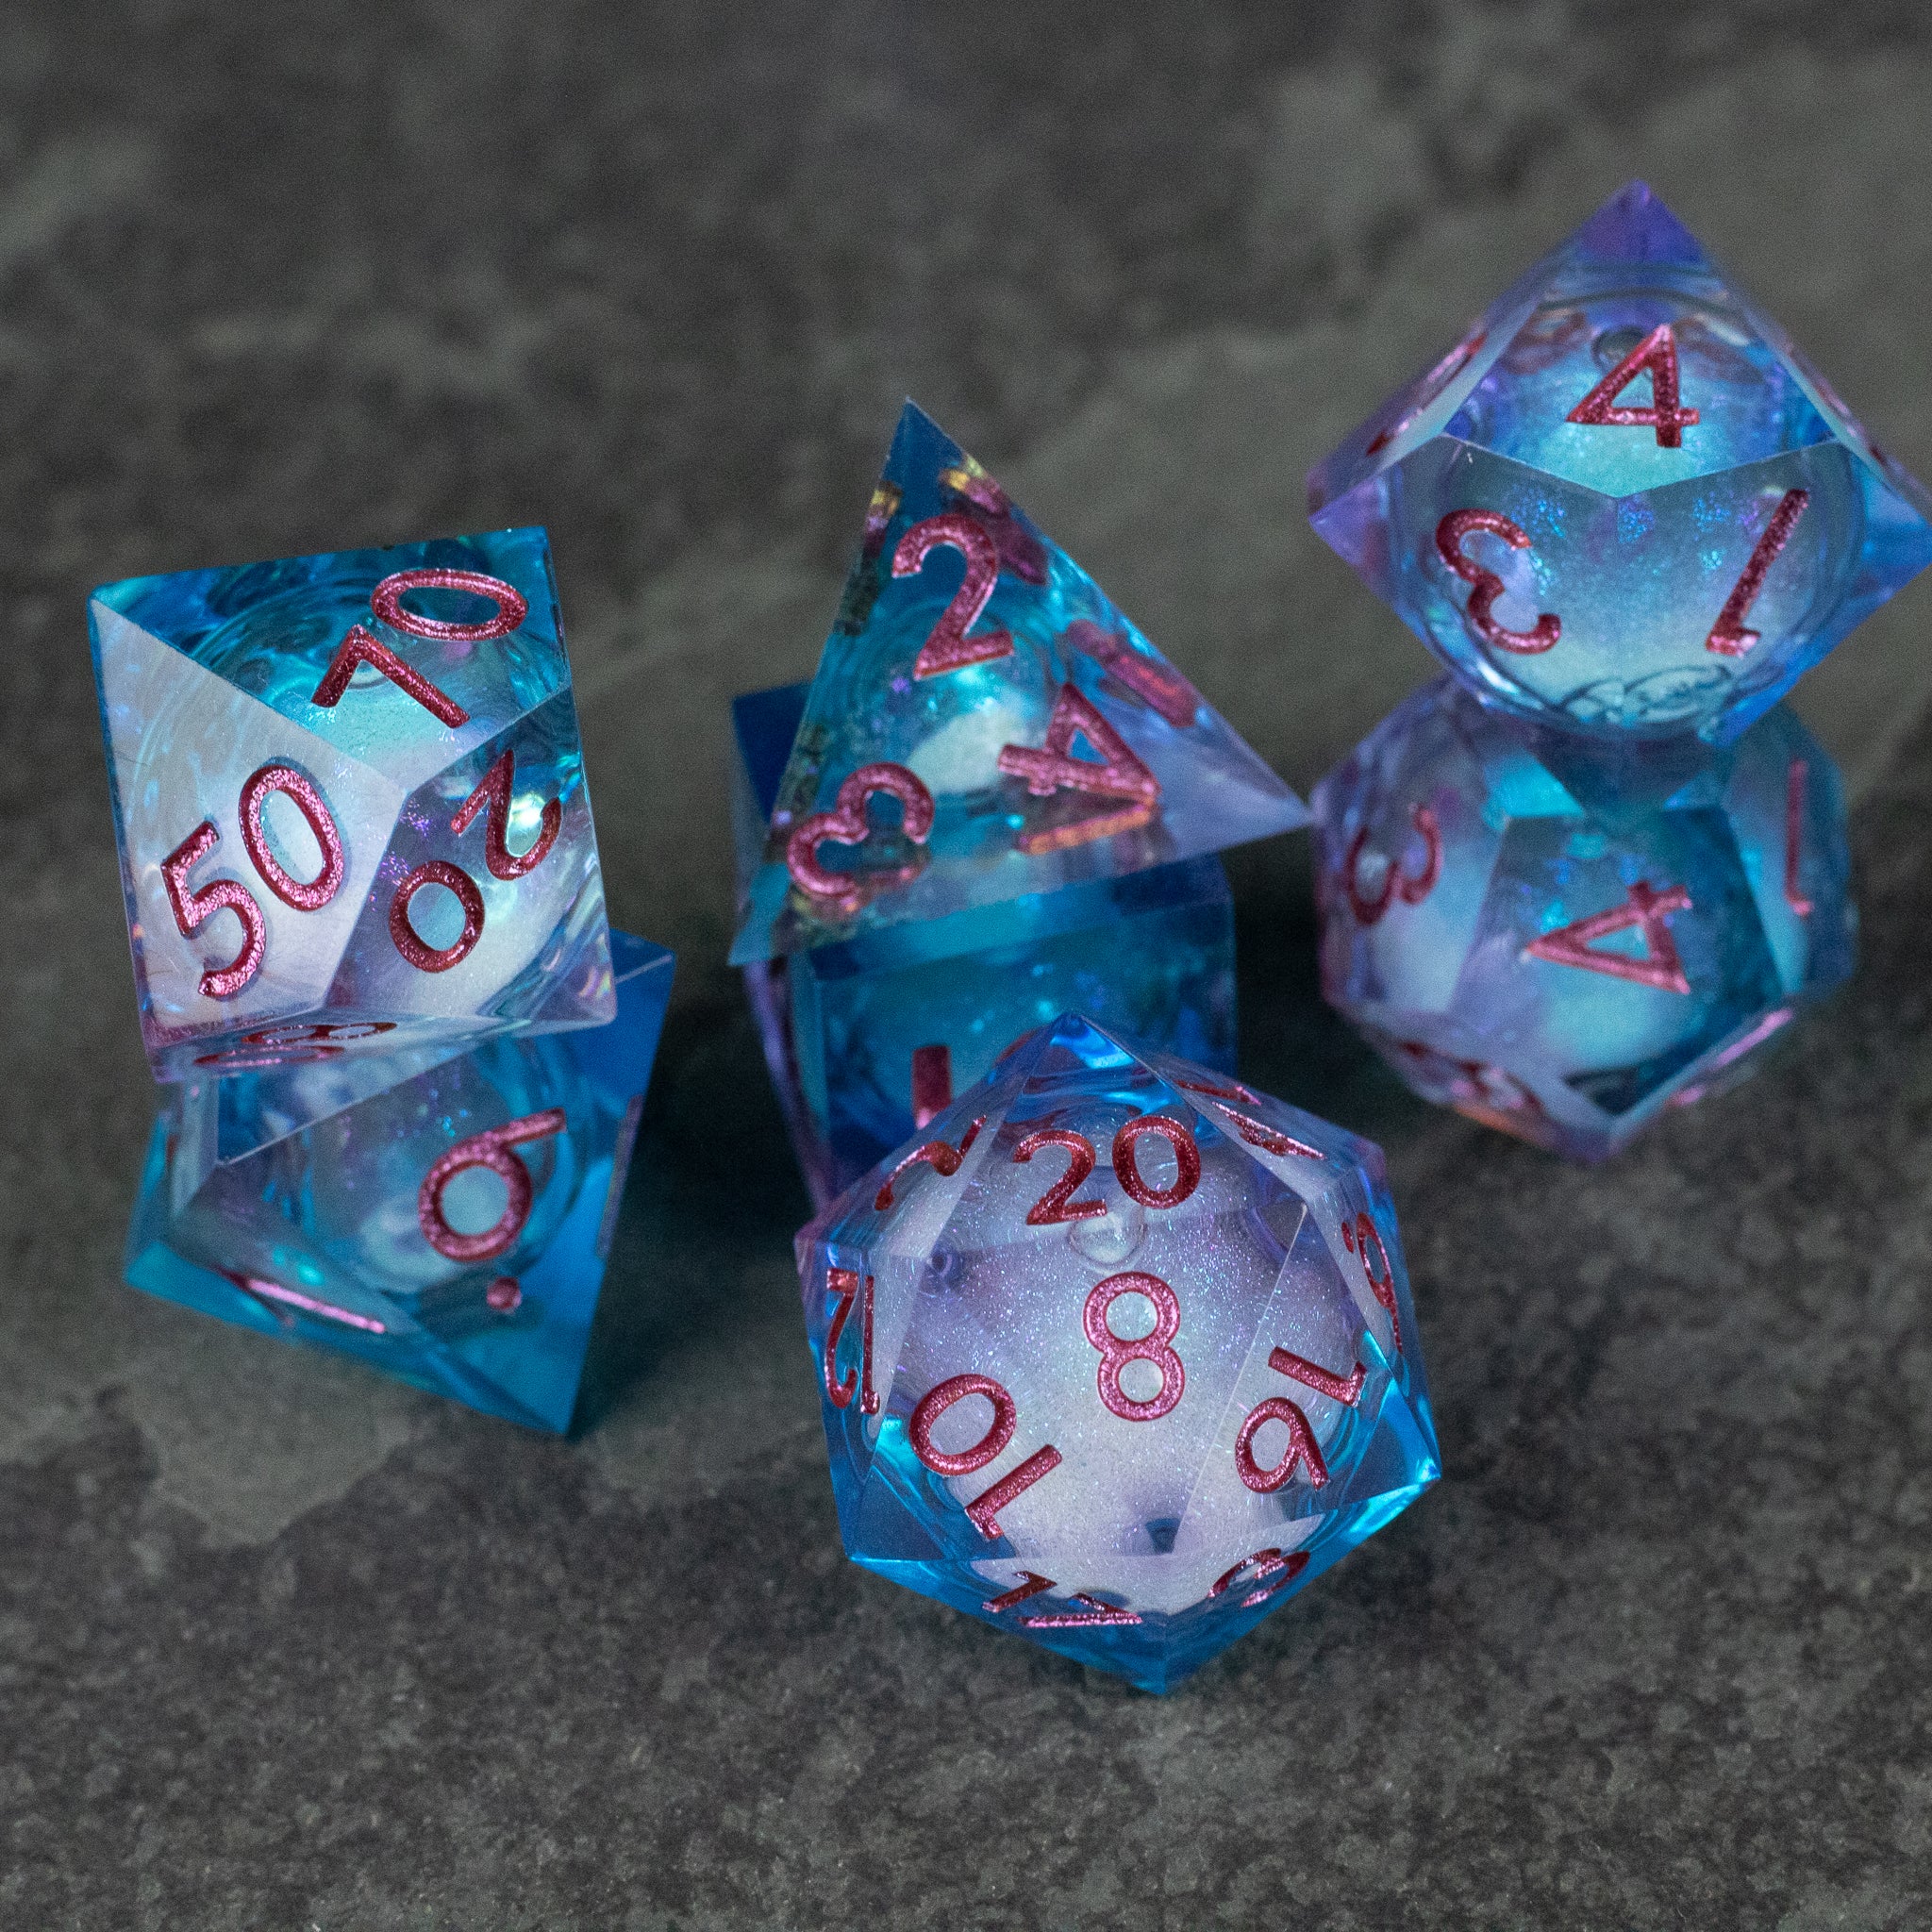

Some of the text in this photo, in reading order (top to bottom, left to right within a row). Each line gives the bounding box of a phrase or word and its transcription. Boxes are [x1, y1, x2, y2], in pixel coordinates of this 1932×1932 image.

[1566, 323, 1699, 448] 4
[312, 568, 528, 729] 70
[891, 513, 1015, 681] 2
[1436, 508, 1561, 656] 3
[997, 683, 1162, 802] 4
[160, 765, 344, 1000] 50
[390, 749, 562, 974] 20
[787, 762, 936, 898] 3
[1344, 802, 1445, 927] 3
[1522, 880, 1693, 996] 4
[1012, 1114, 1201, 1225] 20
[824, 1267, 880, 1415] 12
[1082, 1271, 1186, 1423] 8
[908, 1373, 1062, 1540] 10
[1234, 1341, 1368, 1494] 16
